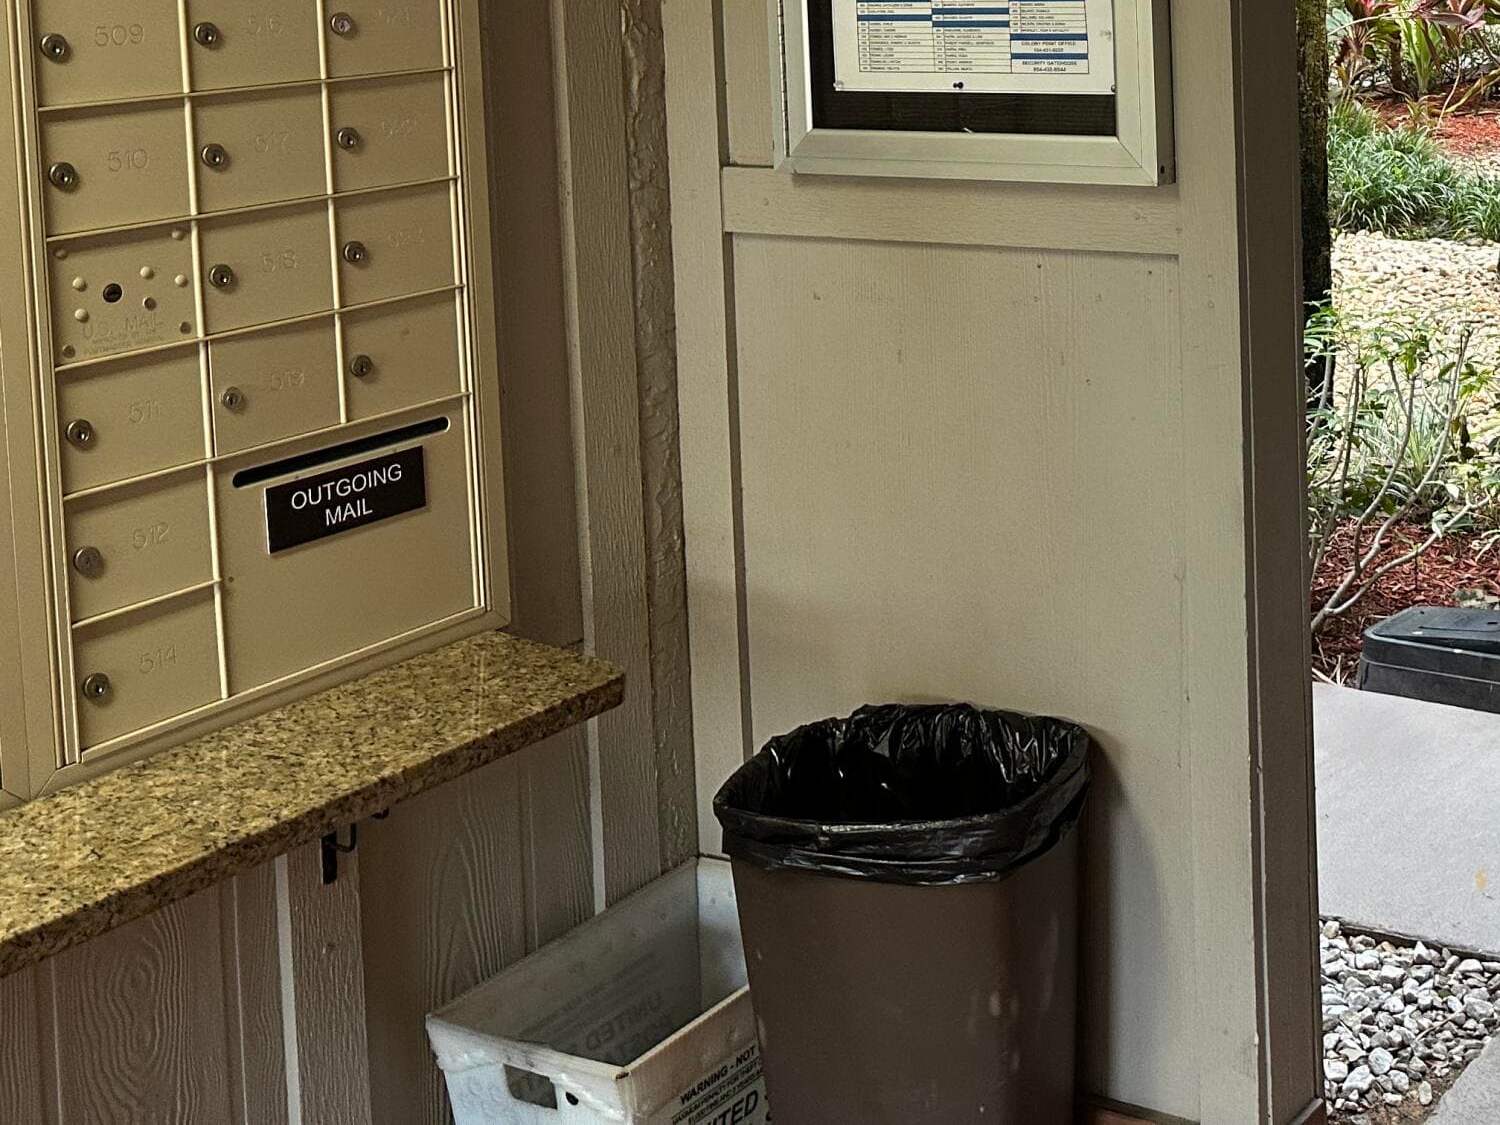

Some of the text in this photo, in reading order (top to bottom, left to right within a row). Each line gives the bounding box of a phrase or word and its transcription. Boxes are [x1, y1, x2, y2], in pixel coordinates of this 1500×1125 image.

[94, 22, 145, 49] 509
[107, 147, 149, 174] 510
[290, 462, 403, 511] OUTGOING
[324, 498, 374, 527] MAIL
[132, 520, 171, 550] 512
[138, 644, 178, 675] 514
[680, 1065, 728, 1105] WARNING
[736, 1044, 756, 1068] NOT
